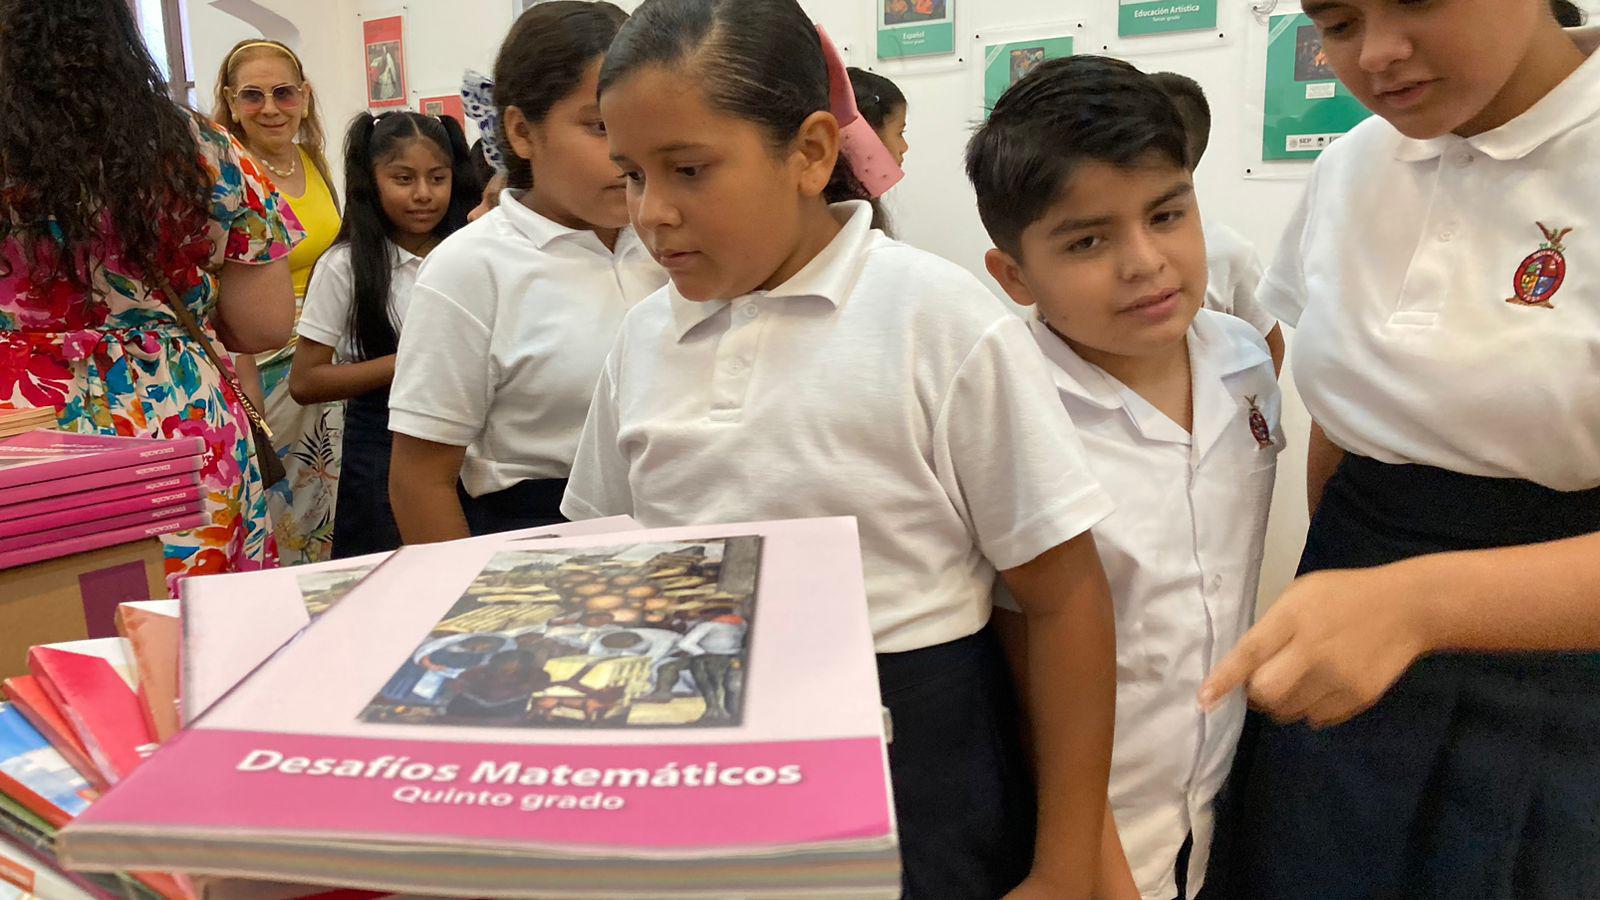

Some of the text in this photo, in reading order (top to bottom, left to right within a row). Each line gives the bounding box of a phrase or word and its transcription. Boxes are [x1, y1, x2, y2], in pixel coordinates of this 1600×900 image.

[1134, 4, 1200, 18] Educación Artística
[235, 749, 802, 788] Desafíos Matemáticos
[392, 785, 625, 812] Quinto grado
